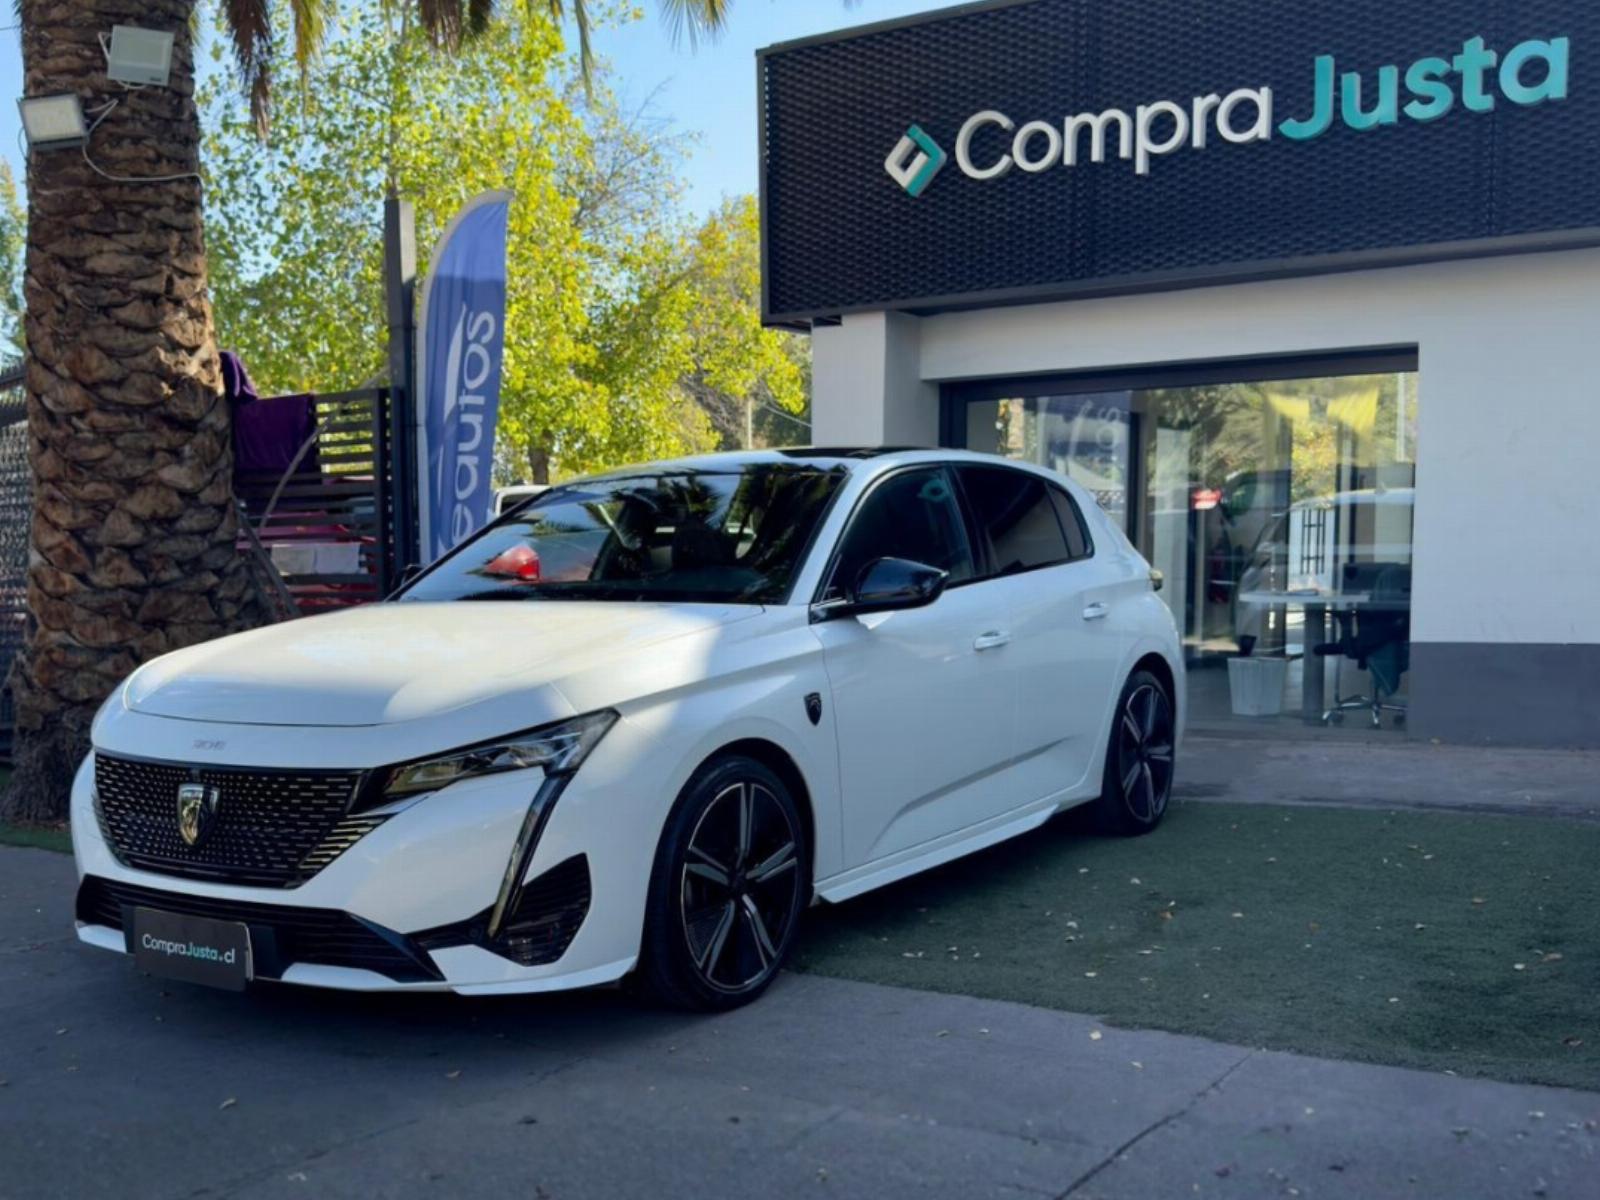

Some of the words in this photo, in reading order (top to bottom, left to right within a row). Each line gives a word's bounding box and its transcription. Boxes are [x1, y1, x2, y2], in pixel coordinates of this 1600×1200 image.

[955, 86, 1273, 178] Compra
[1278, 35, 1569, 140] Justa
[142, 933, 236, 964] CompraJusta.cl
